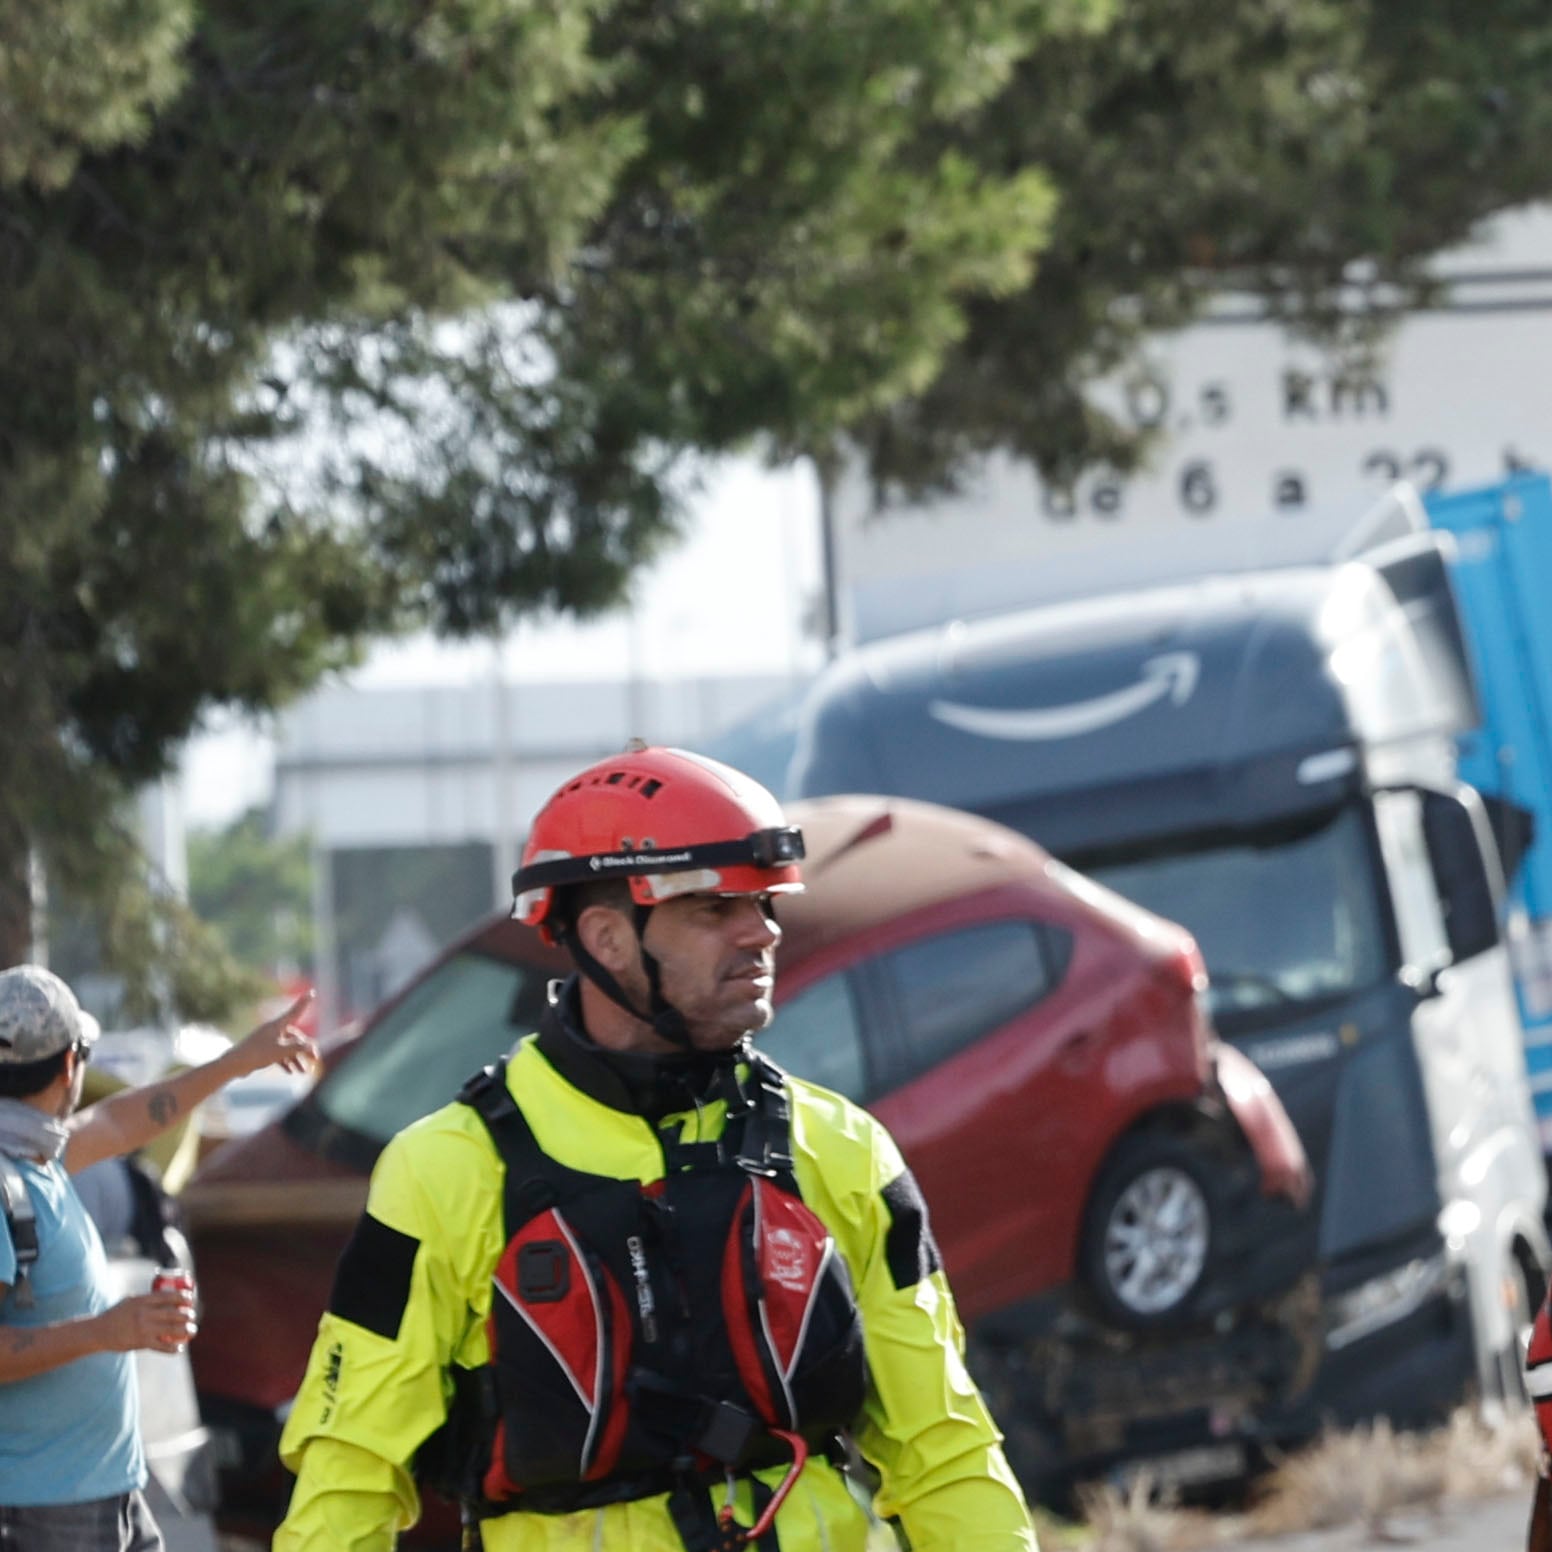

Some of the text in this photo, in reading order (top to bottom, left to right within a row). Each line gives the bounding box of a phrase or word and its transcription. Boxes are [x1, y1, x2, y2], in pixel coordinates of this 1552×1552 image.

[1280, 368, 1391, 422] km
[1178, 459, 1217, 516] 6
[1274, 470, 1306, 510] a
